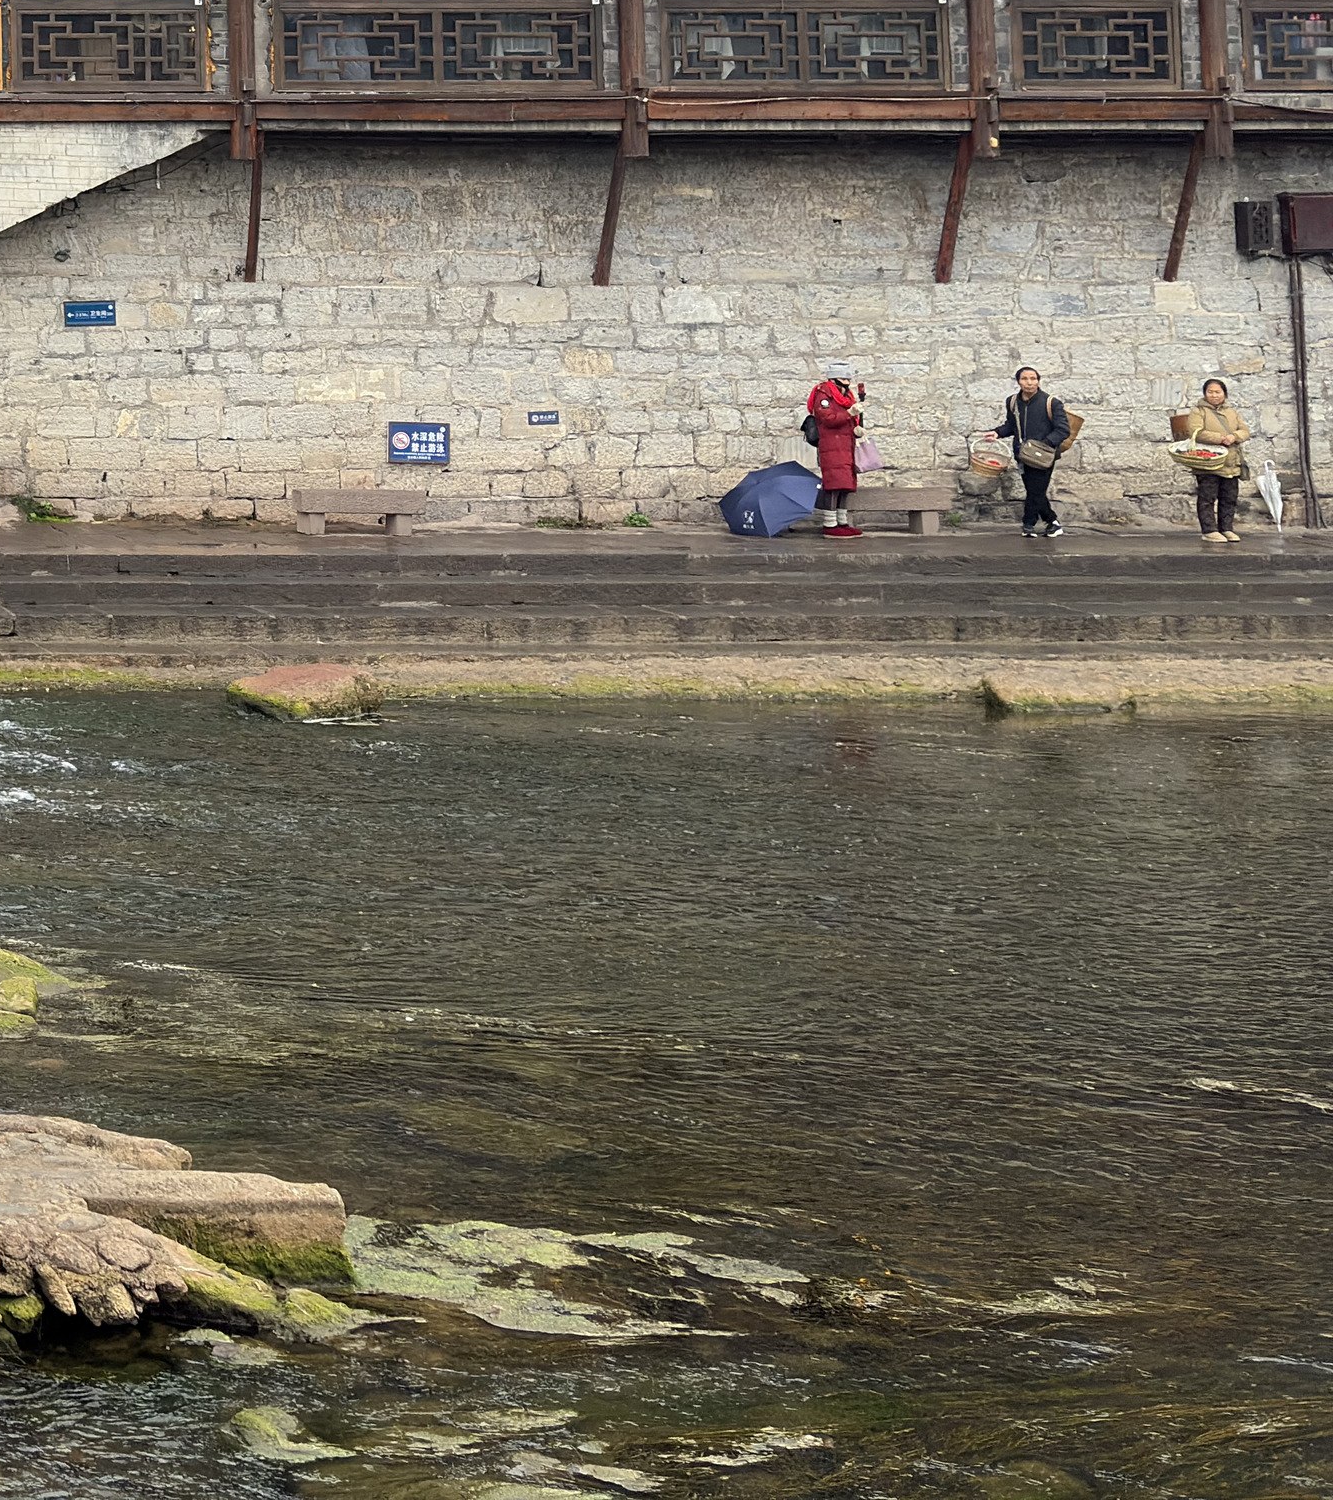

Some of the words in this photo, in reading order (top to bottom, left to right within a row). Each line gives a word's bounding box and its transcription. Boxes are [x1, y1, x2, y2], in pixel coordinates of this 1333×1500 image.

[411, 431, 445, 442] 水深危险
[411, 442, 445, 453] 禁止游泳
